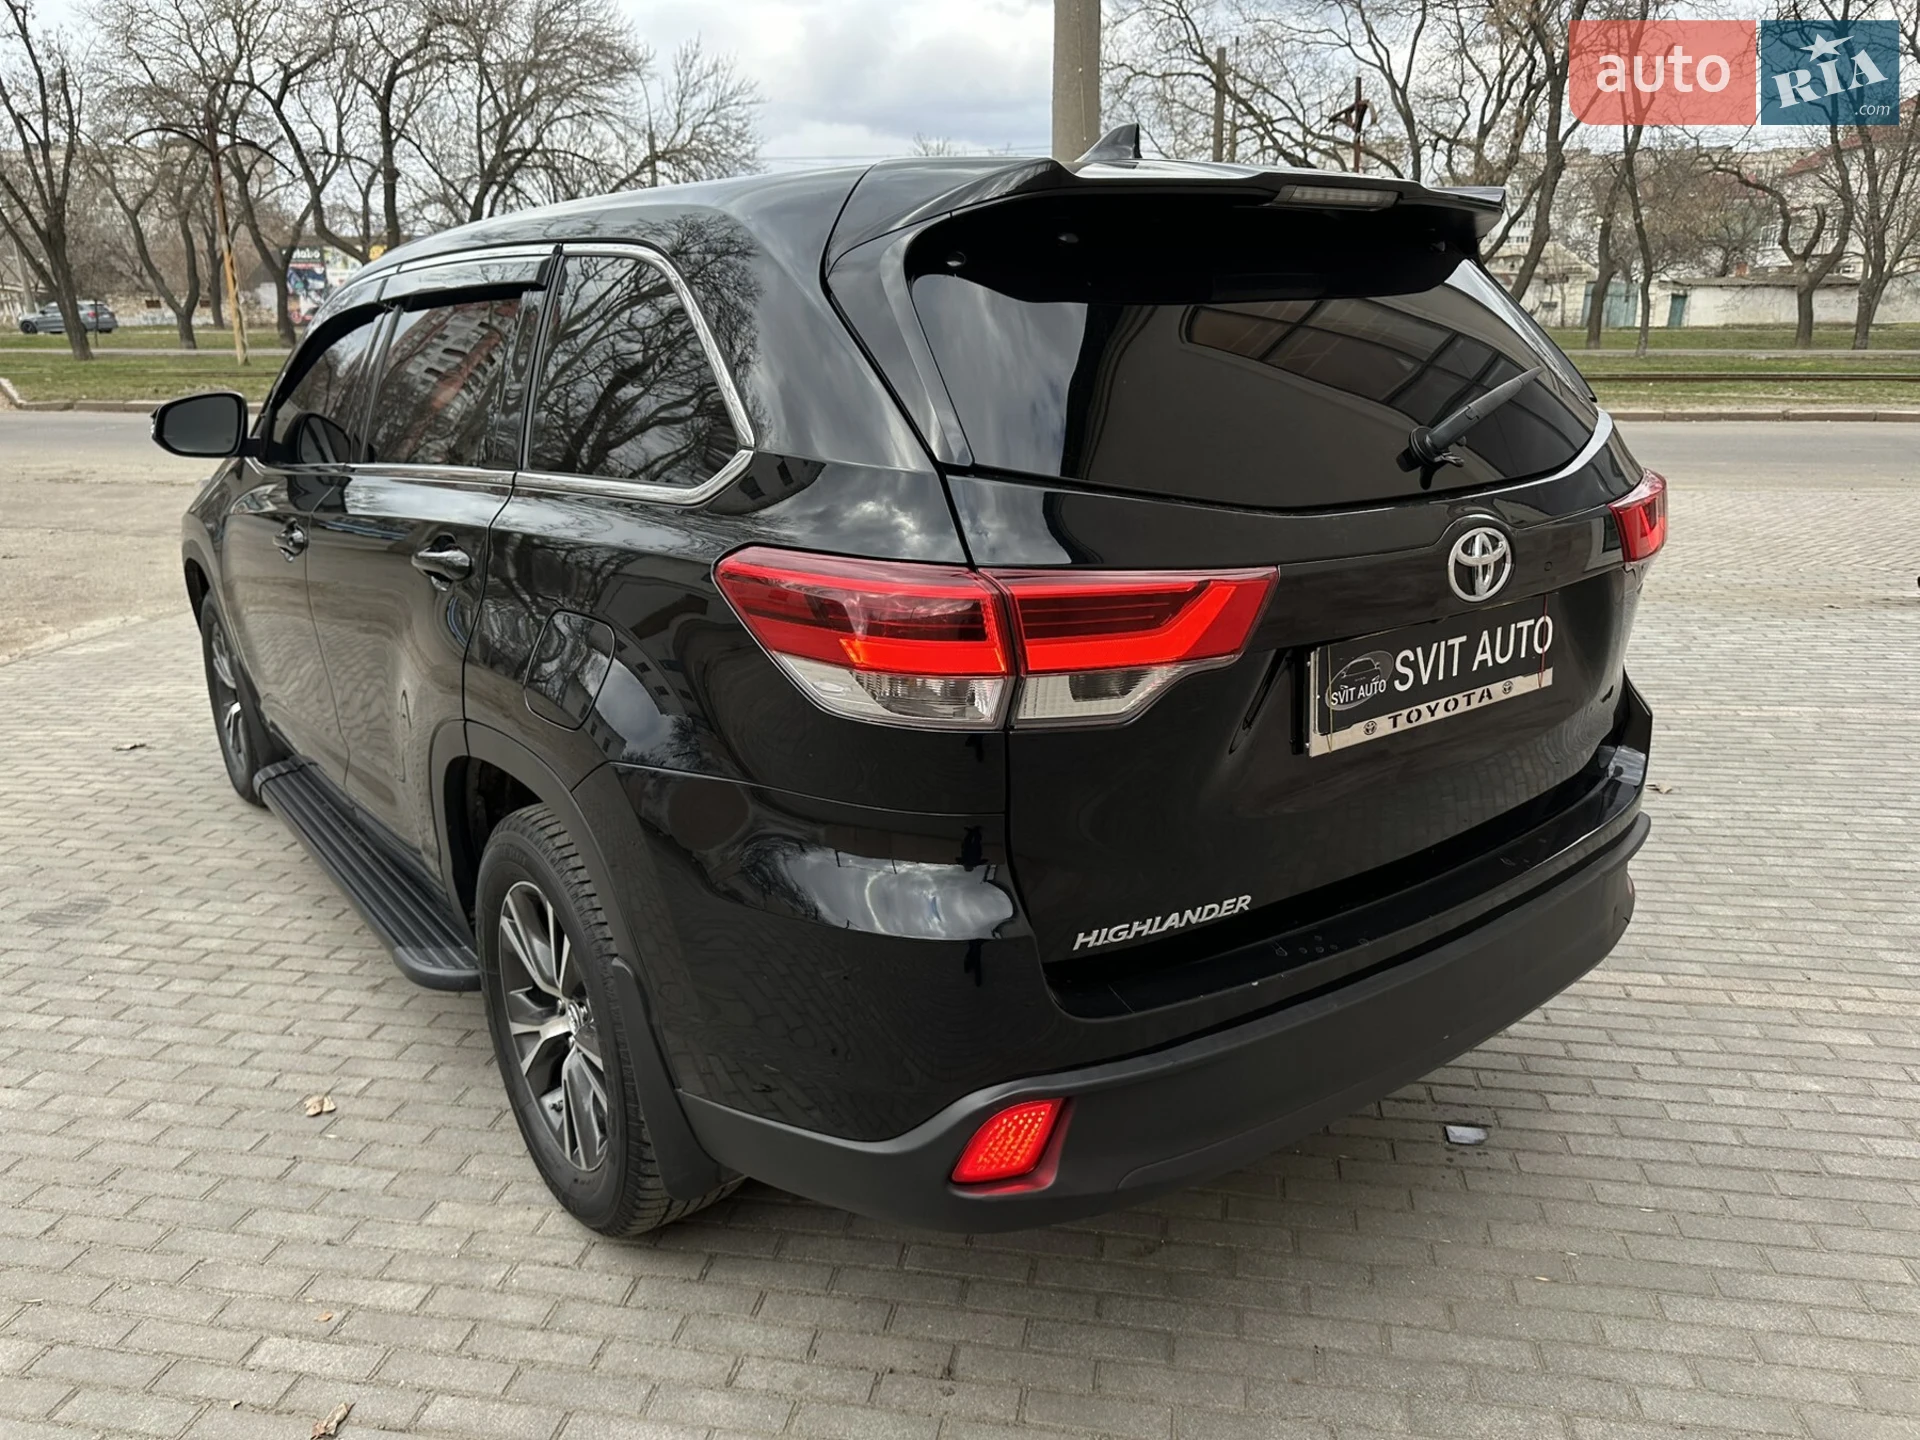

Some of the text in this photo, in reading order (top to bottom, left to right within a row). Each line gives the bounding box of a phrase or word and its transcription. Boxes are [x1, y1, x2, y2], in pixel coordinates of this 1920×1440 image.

[1393, 615, 1553, 692] SVIT AUTO
[1330, 679, 1387, 706] SVIT AUTO
[1387, 687, 1494, 730] TOYOTA
[1072, 894, 1252, 951] HIGHLANDER
